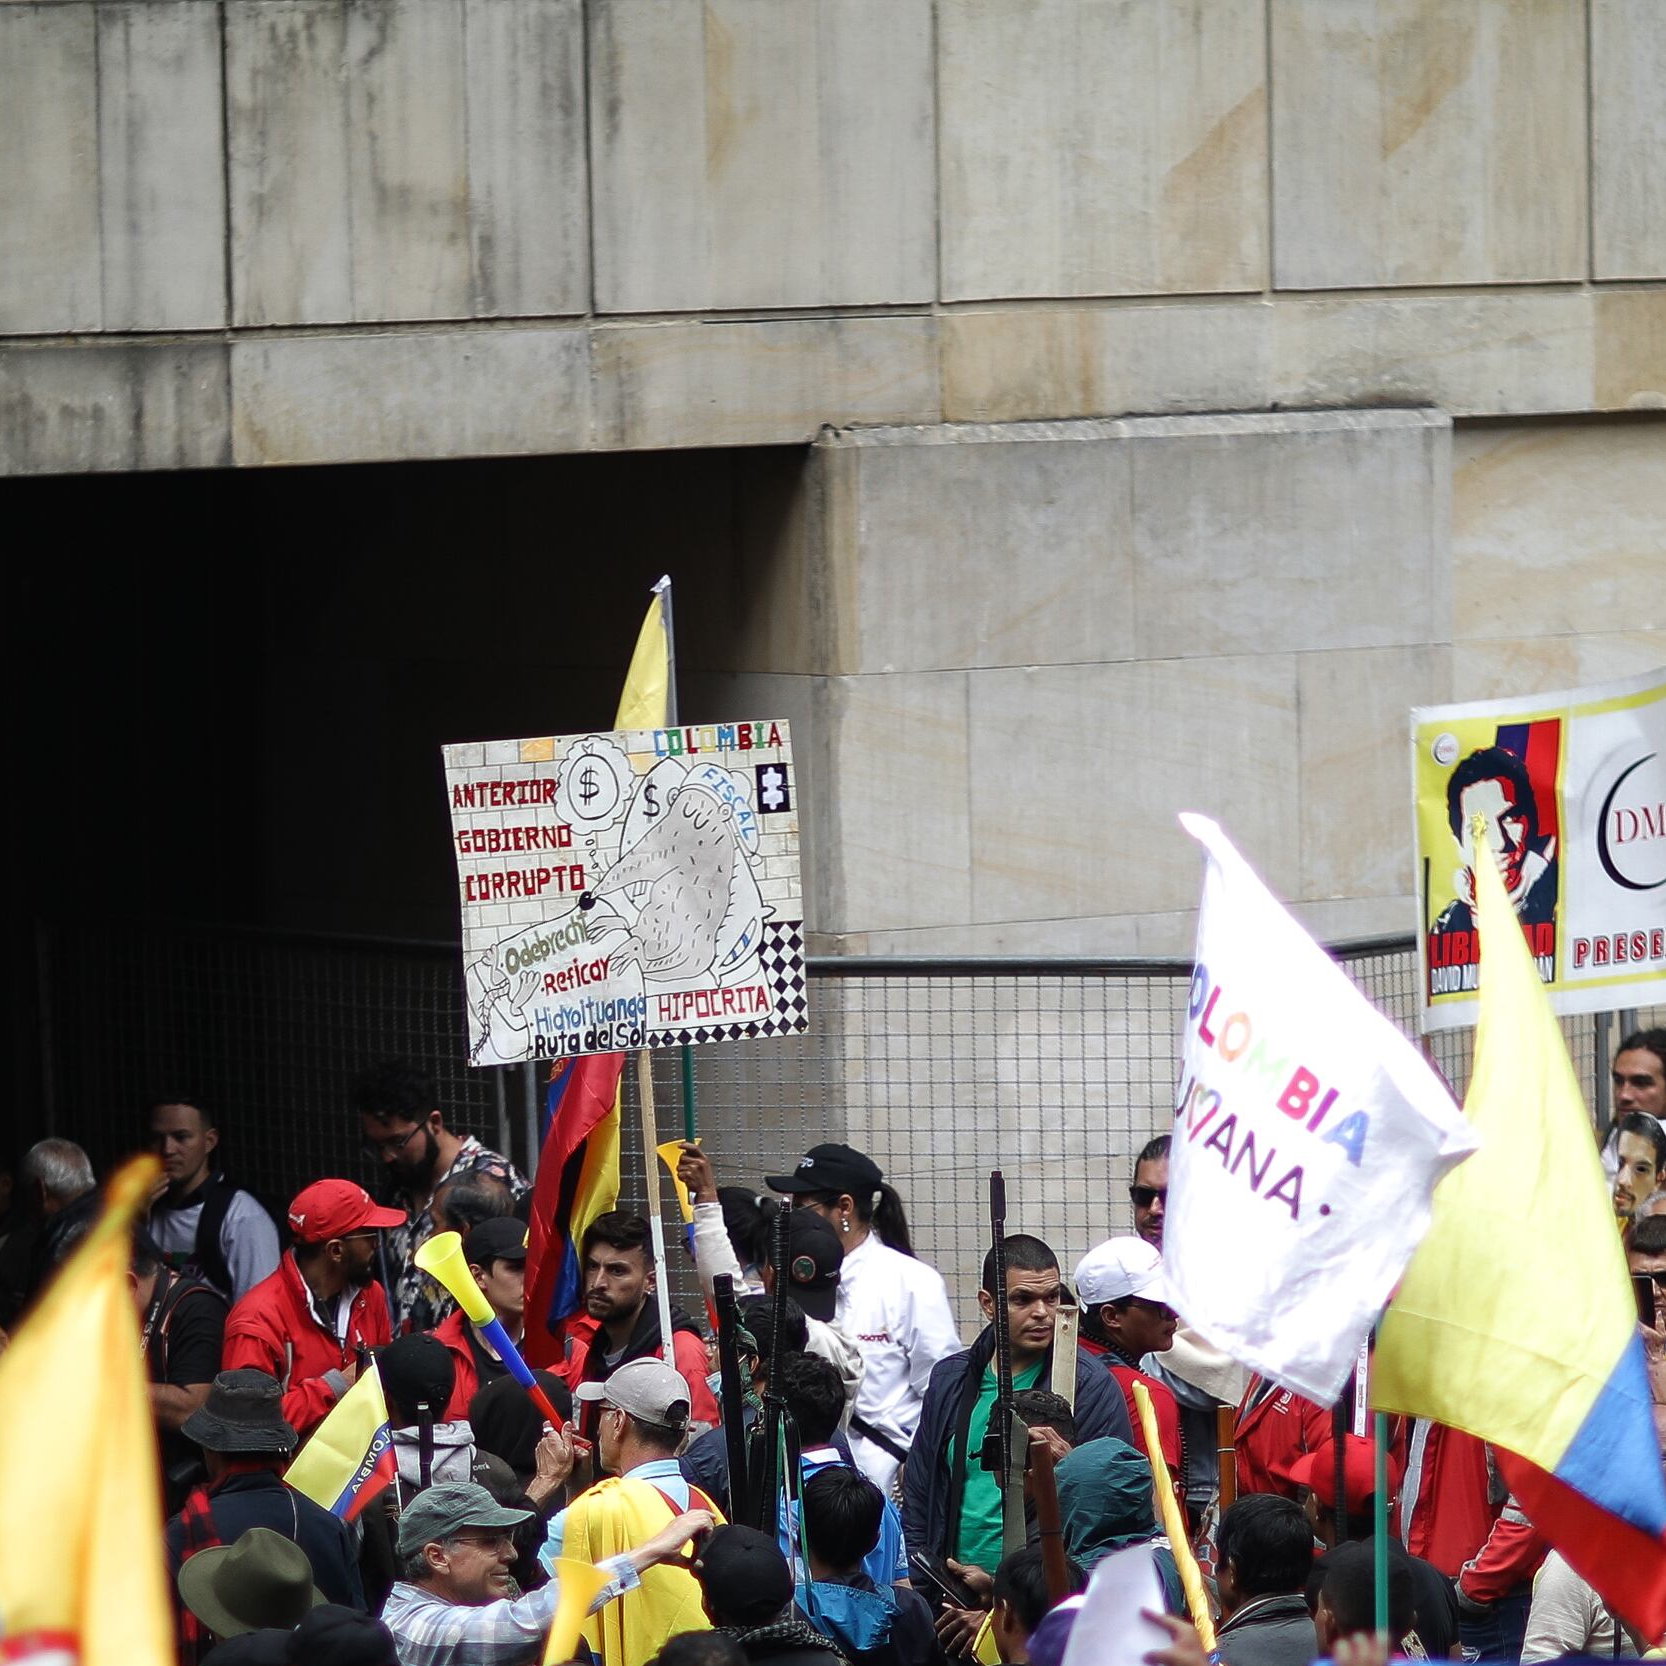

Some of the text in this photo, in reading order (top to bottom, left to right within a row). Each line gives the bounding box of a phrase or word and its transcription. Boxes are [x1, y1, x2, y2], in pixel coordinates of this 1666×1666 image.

[653, 722, 783, 757] COLOMBIA
[452, 779, 556, 808] ANTERIOR
[701, 767, 752, 841] FISCAL
[457, 825, 572, 853] GOBIERNO
[465, 864, 586, 900] CORRUPTO
[658, 985, 770, 1022] HIPOCRITA
[535, 1020, 646, 1058] Ruta del Sol
[1190, 963, 1370, 1168] OLOMBIA
